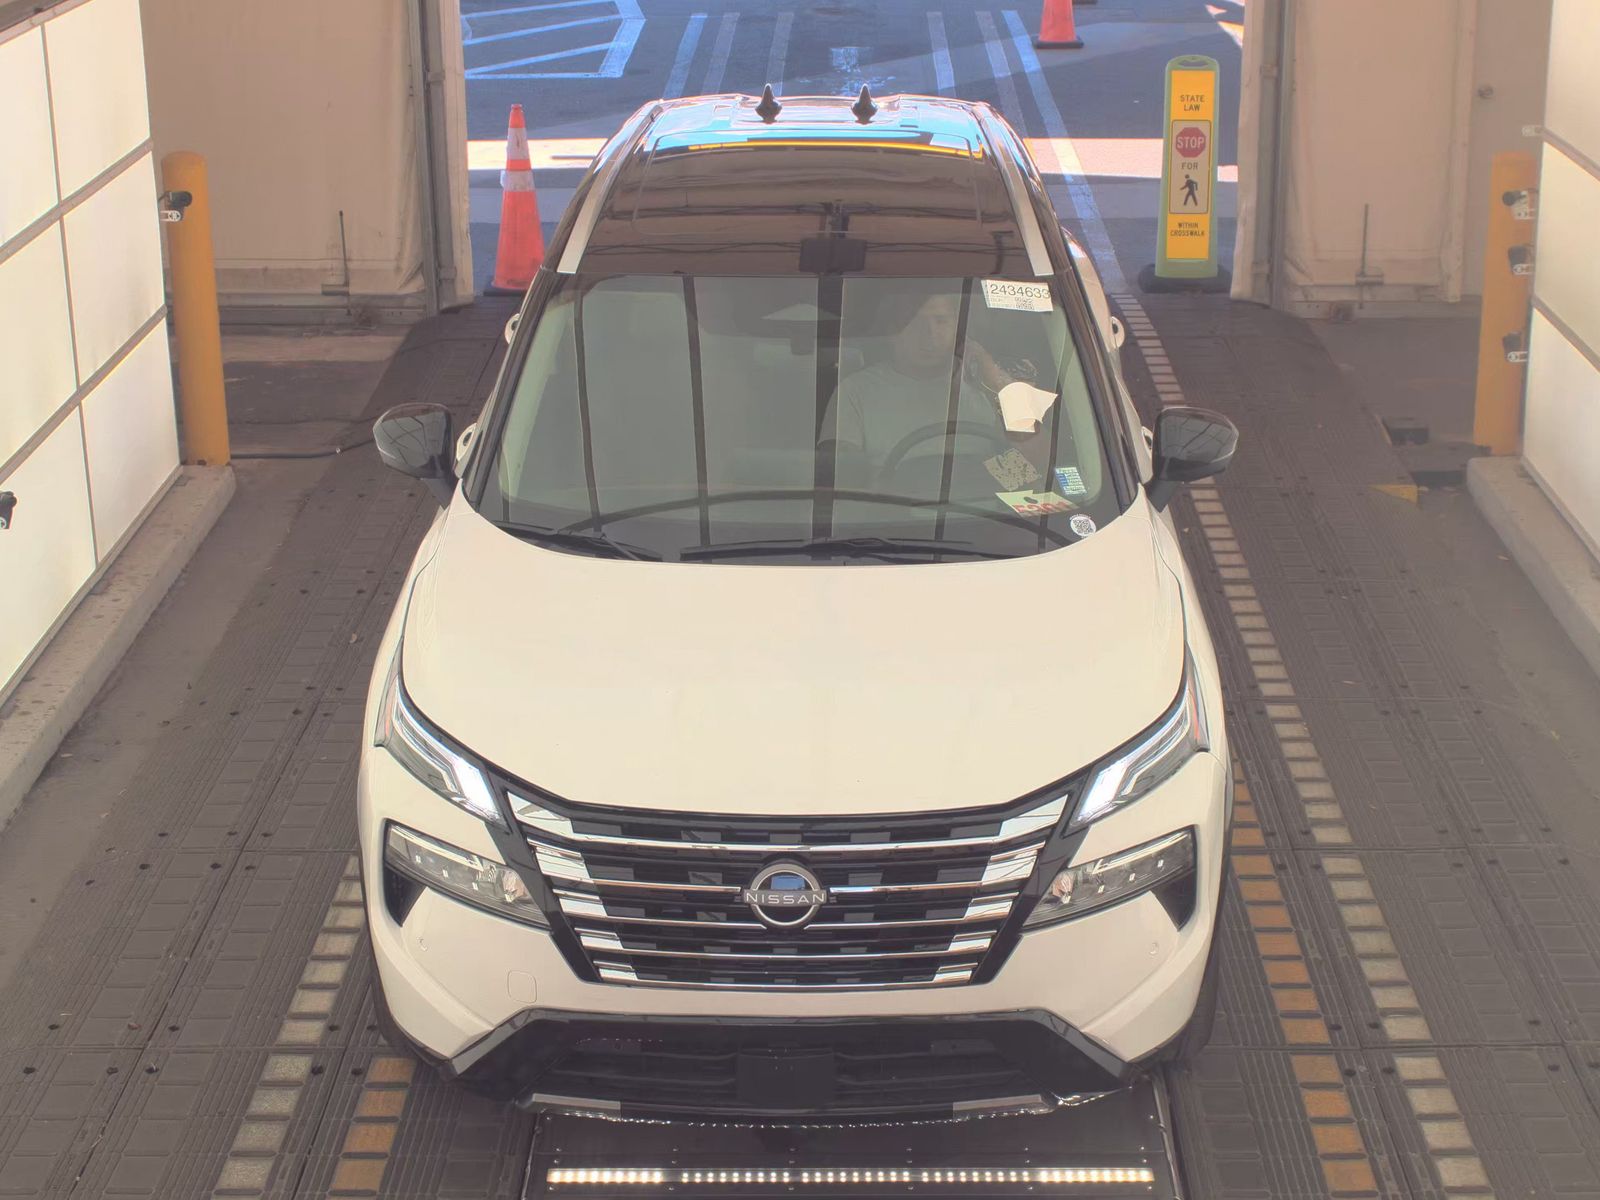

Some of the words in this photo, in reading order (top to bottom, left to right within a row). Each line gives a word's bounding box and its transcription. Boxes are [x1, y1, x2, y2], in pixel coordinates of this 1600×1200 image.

[1180, 94, 1205, 103] STATE
[1184, 104, 1201, 112] LAW
[1176, 136, 1205, 149] STOP
[1181, 162, 1199, 170] FOR
[990, 283, 1051, 299] 2434633
[746, 892, 825, 905] NISSAN
